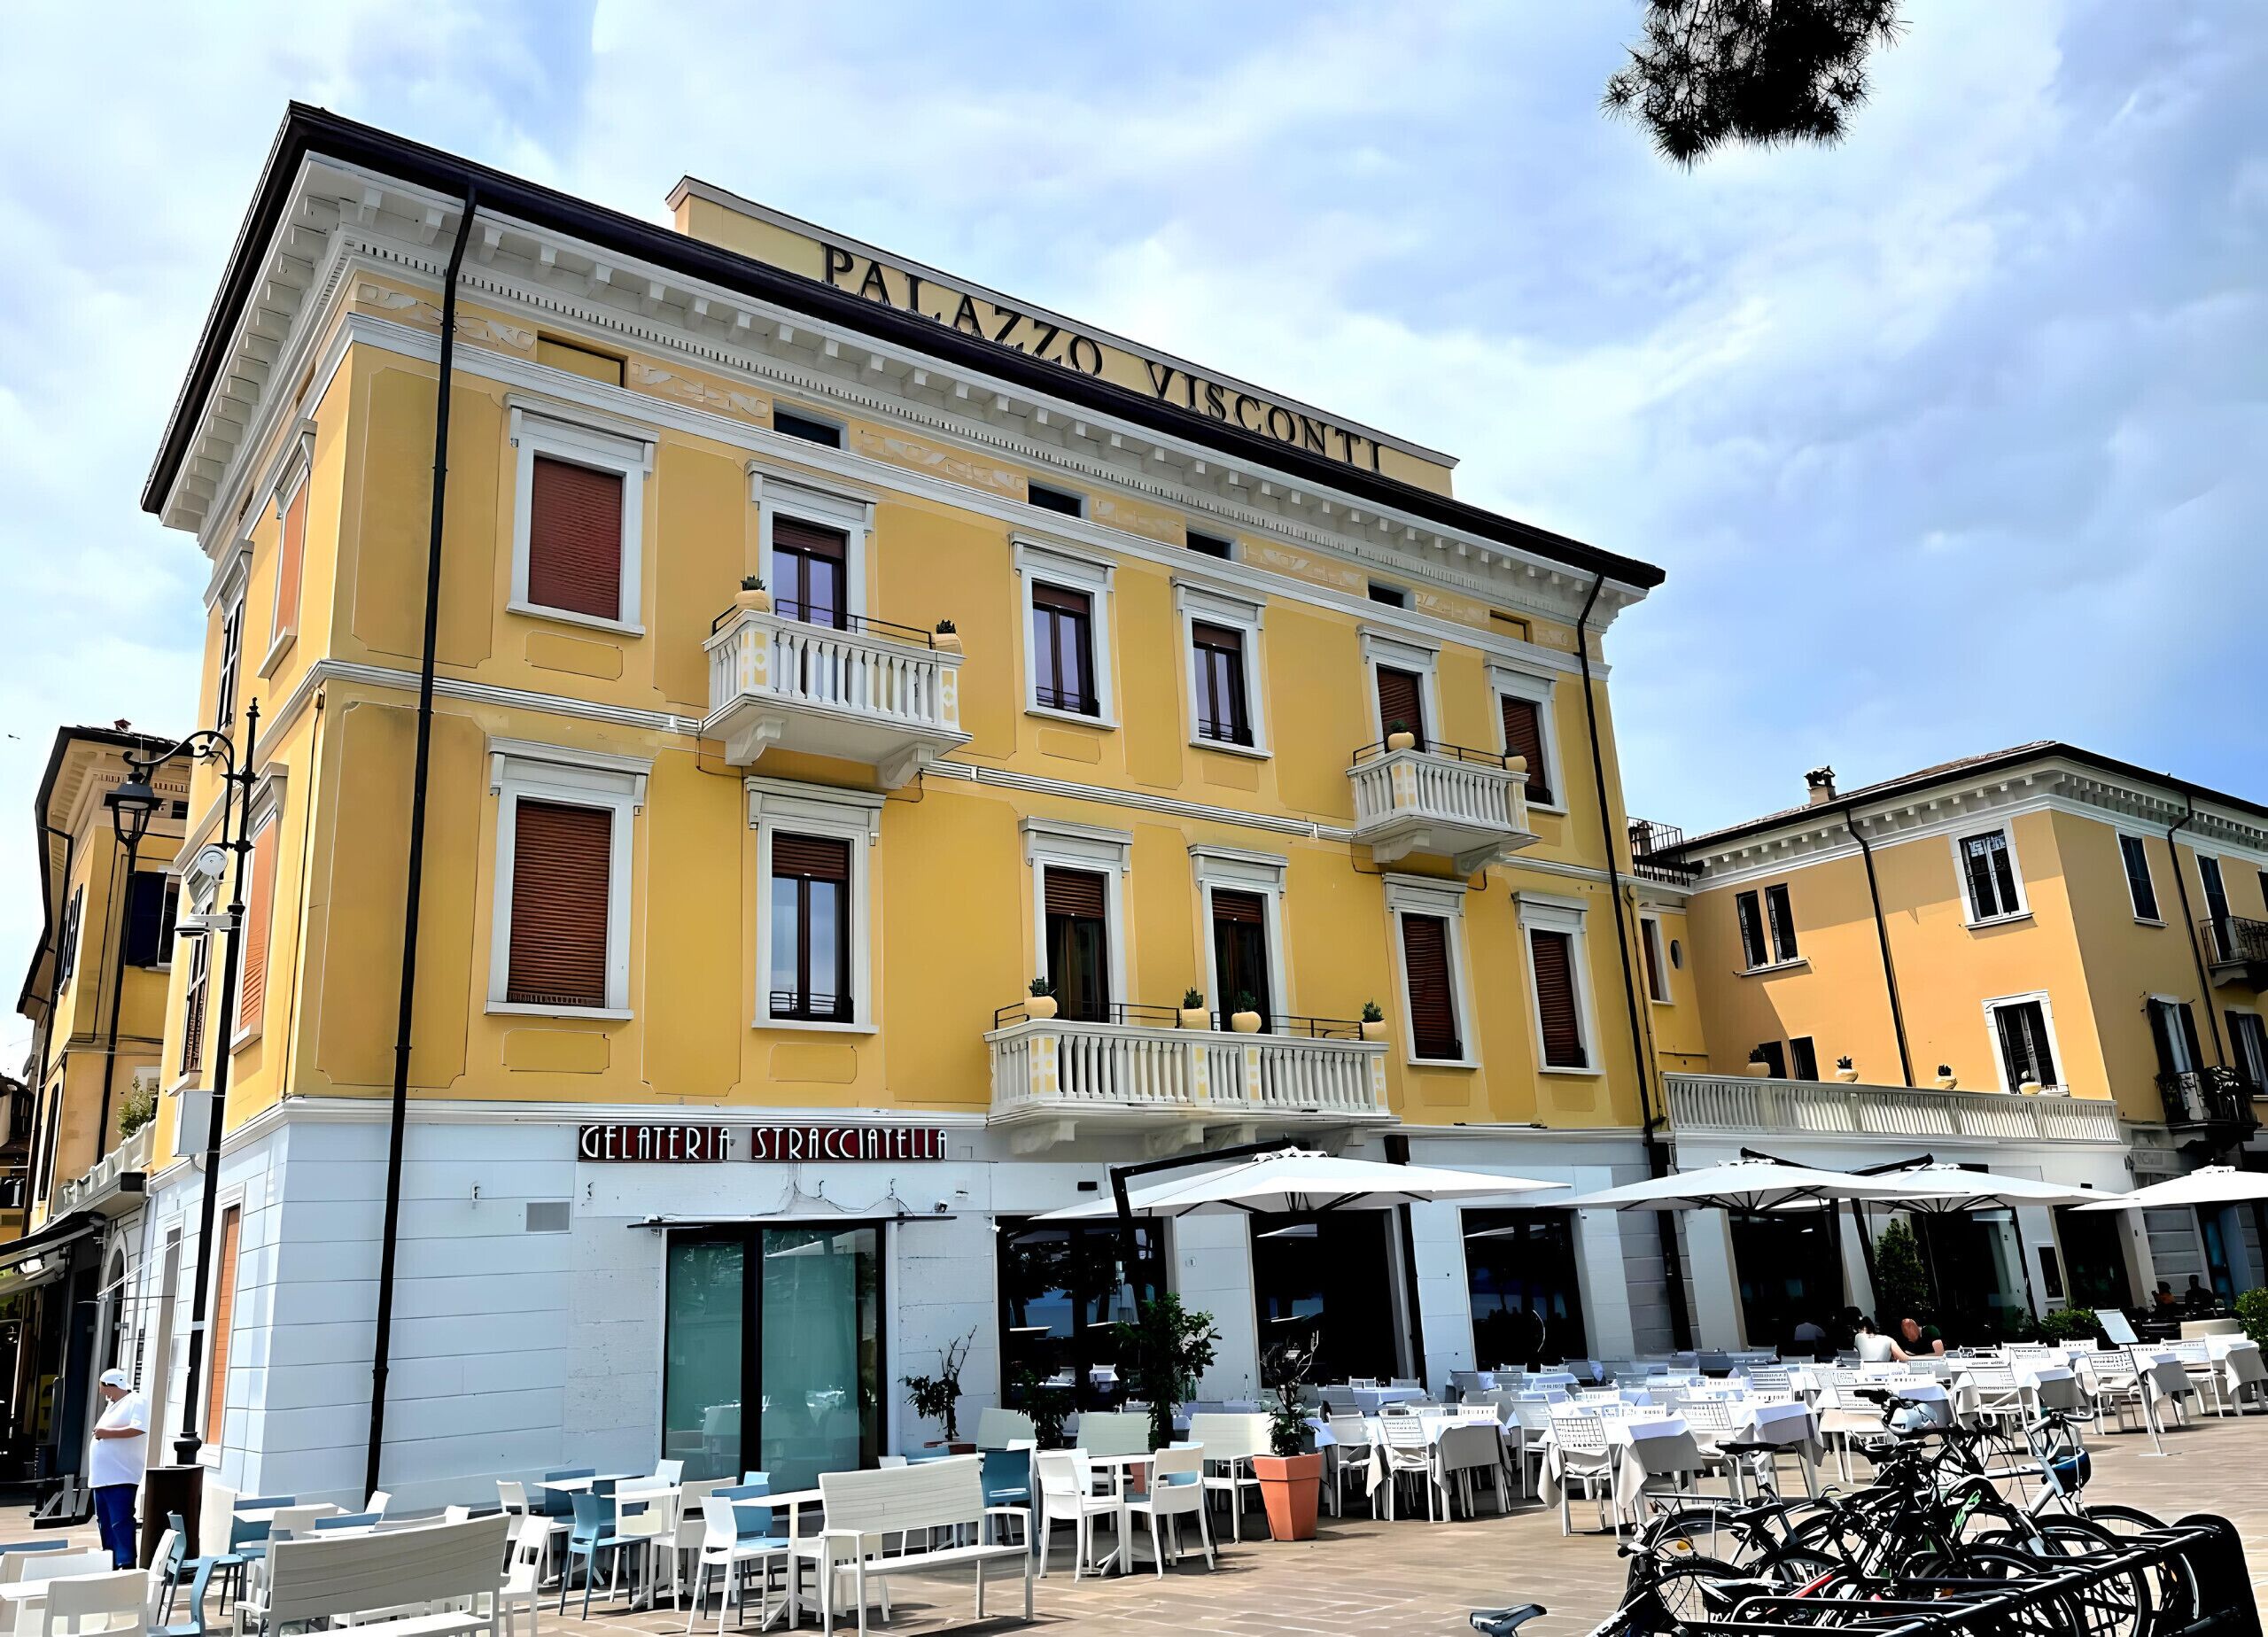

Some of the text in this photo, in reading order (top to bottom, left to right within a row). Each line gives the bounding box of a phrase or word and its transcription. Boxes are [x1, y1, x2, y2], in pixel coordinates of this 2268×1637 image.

[820, 242, 1381, 474] PALAZZO VISCONTI
[581, 1125, 947, 1160] GELATERIA STRACCIATELLA
